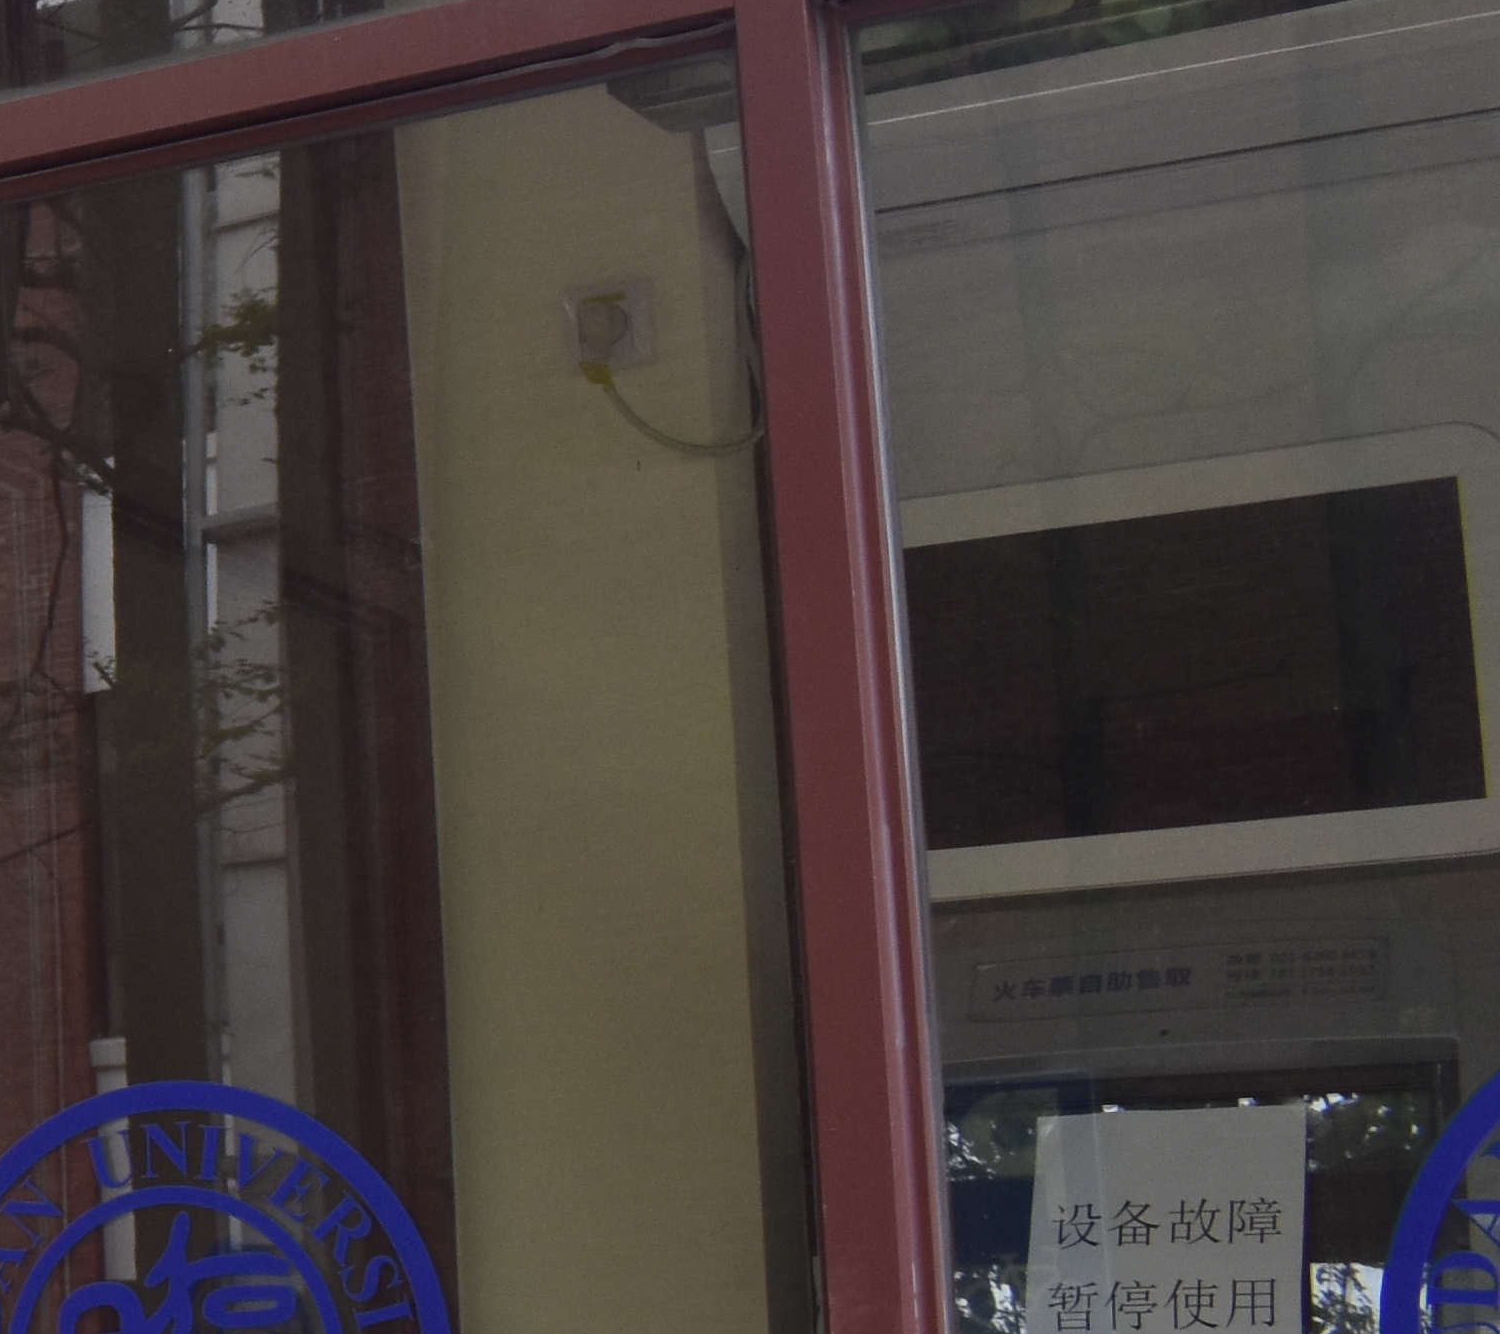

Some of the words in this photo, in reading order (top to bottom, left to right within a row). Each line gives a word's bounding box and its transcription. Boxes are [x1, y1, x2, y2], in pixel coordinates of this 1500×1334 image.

[1051, 1197, 1284, 1249] 设备故障
[1047, 1276, 1278, 1333] 暂停使用
